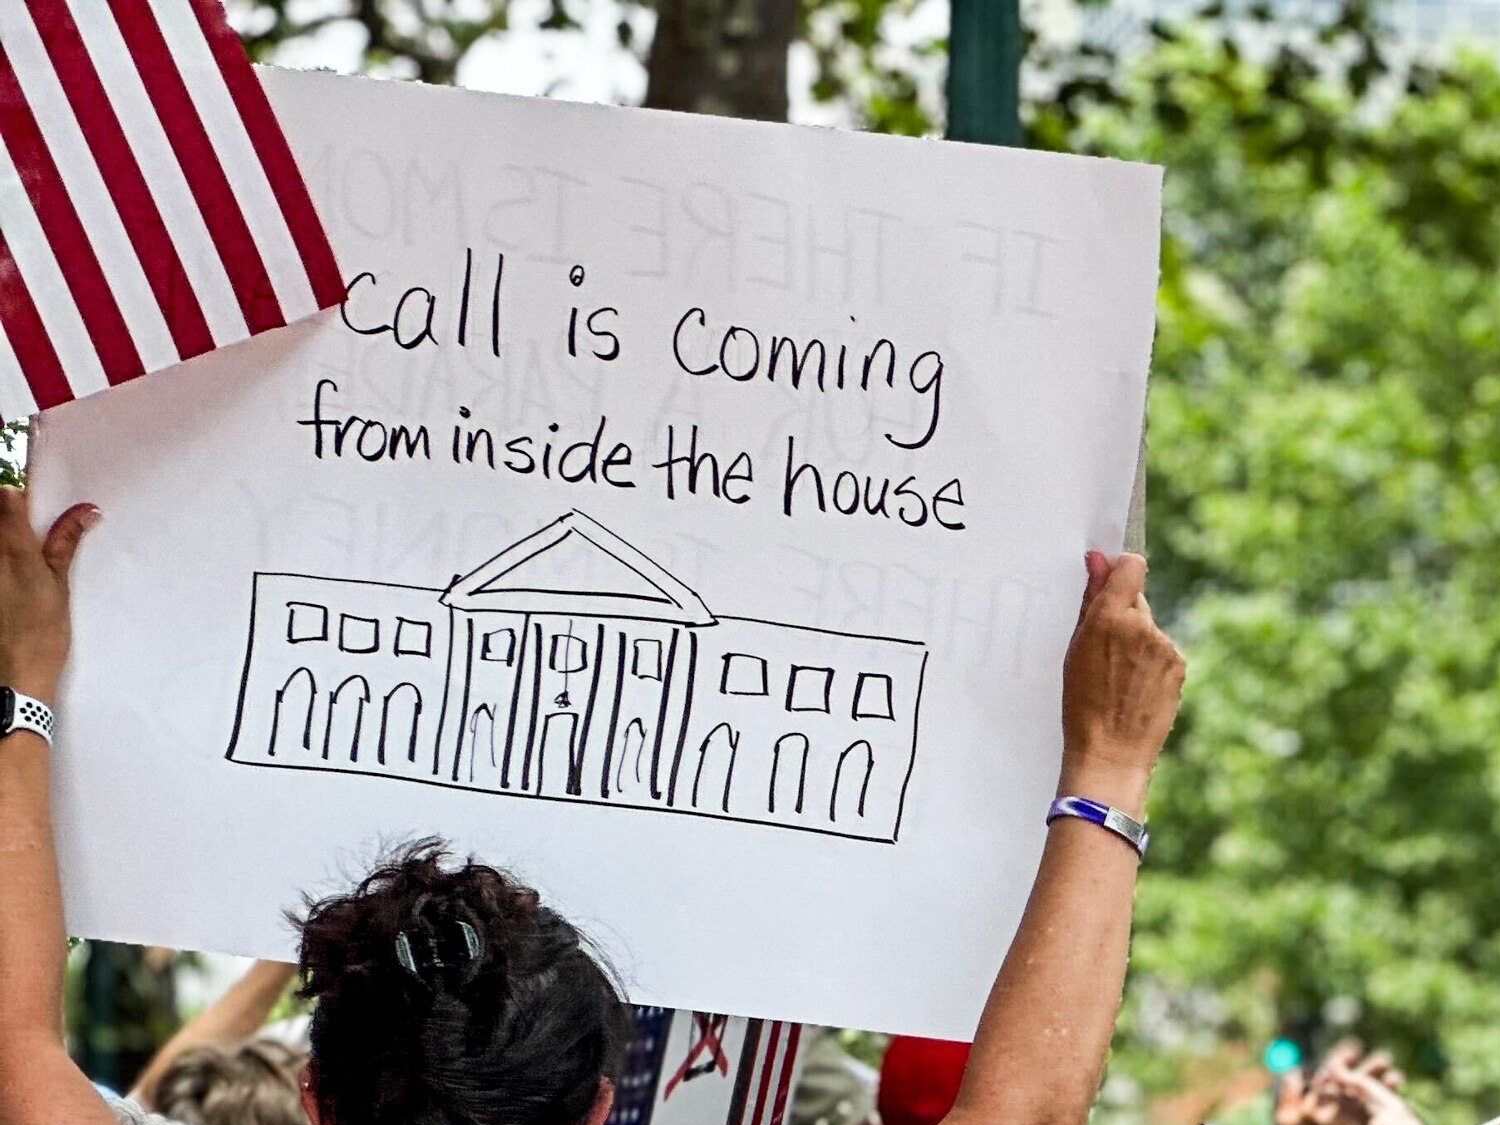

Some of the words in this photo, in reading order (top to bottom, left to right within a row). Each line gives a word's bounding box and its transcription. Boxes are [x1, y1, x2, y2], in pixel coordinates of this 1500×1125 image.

[338, 247, 504, 358] call
[568, 264, 620, 362] is
[672, 307, 944, 450] coming
[296, 378, 431, 462] from
[452, 406, 637, 488] inside
[651, 424, 753, 505] the
[783, 435, 966, 531] house
